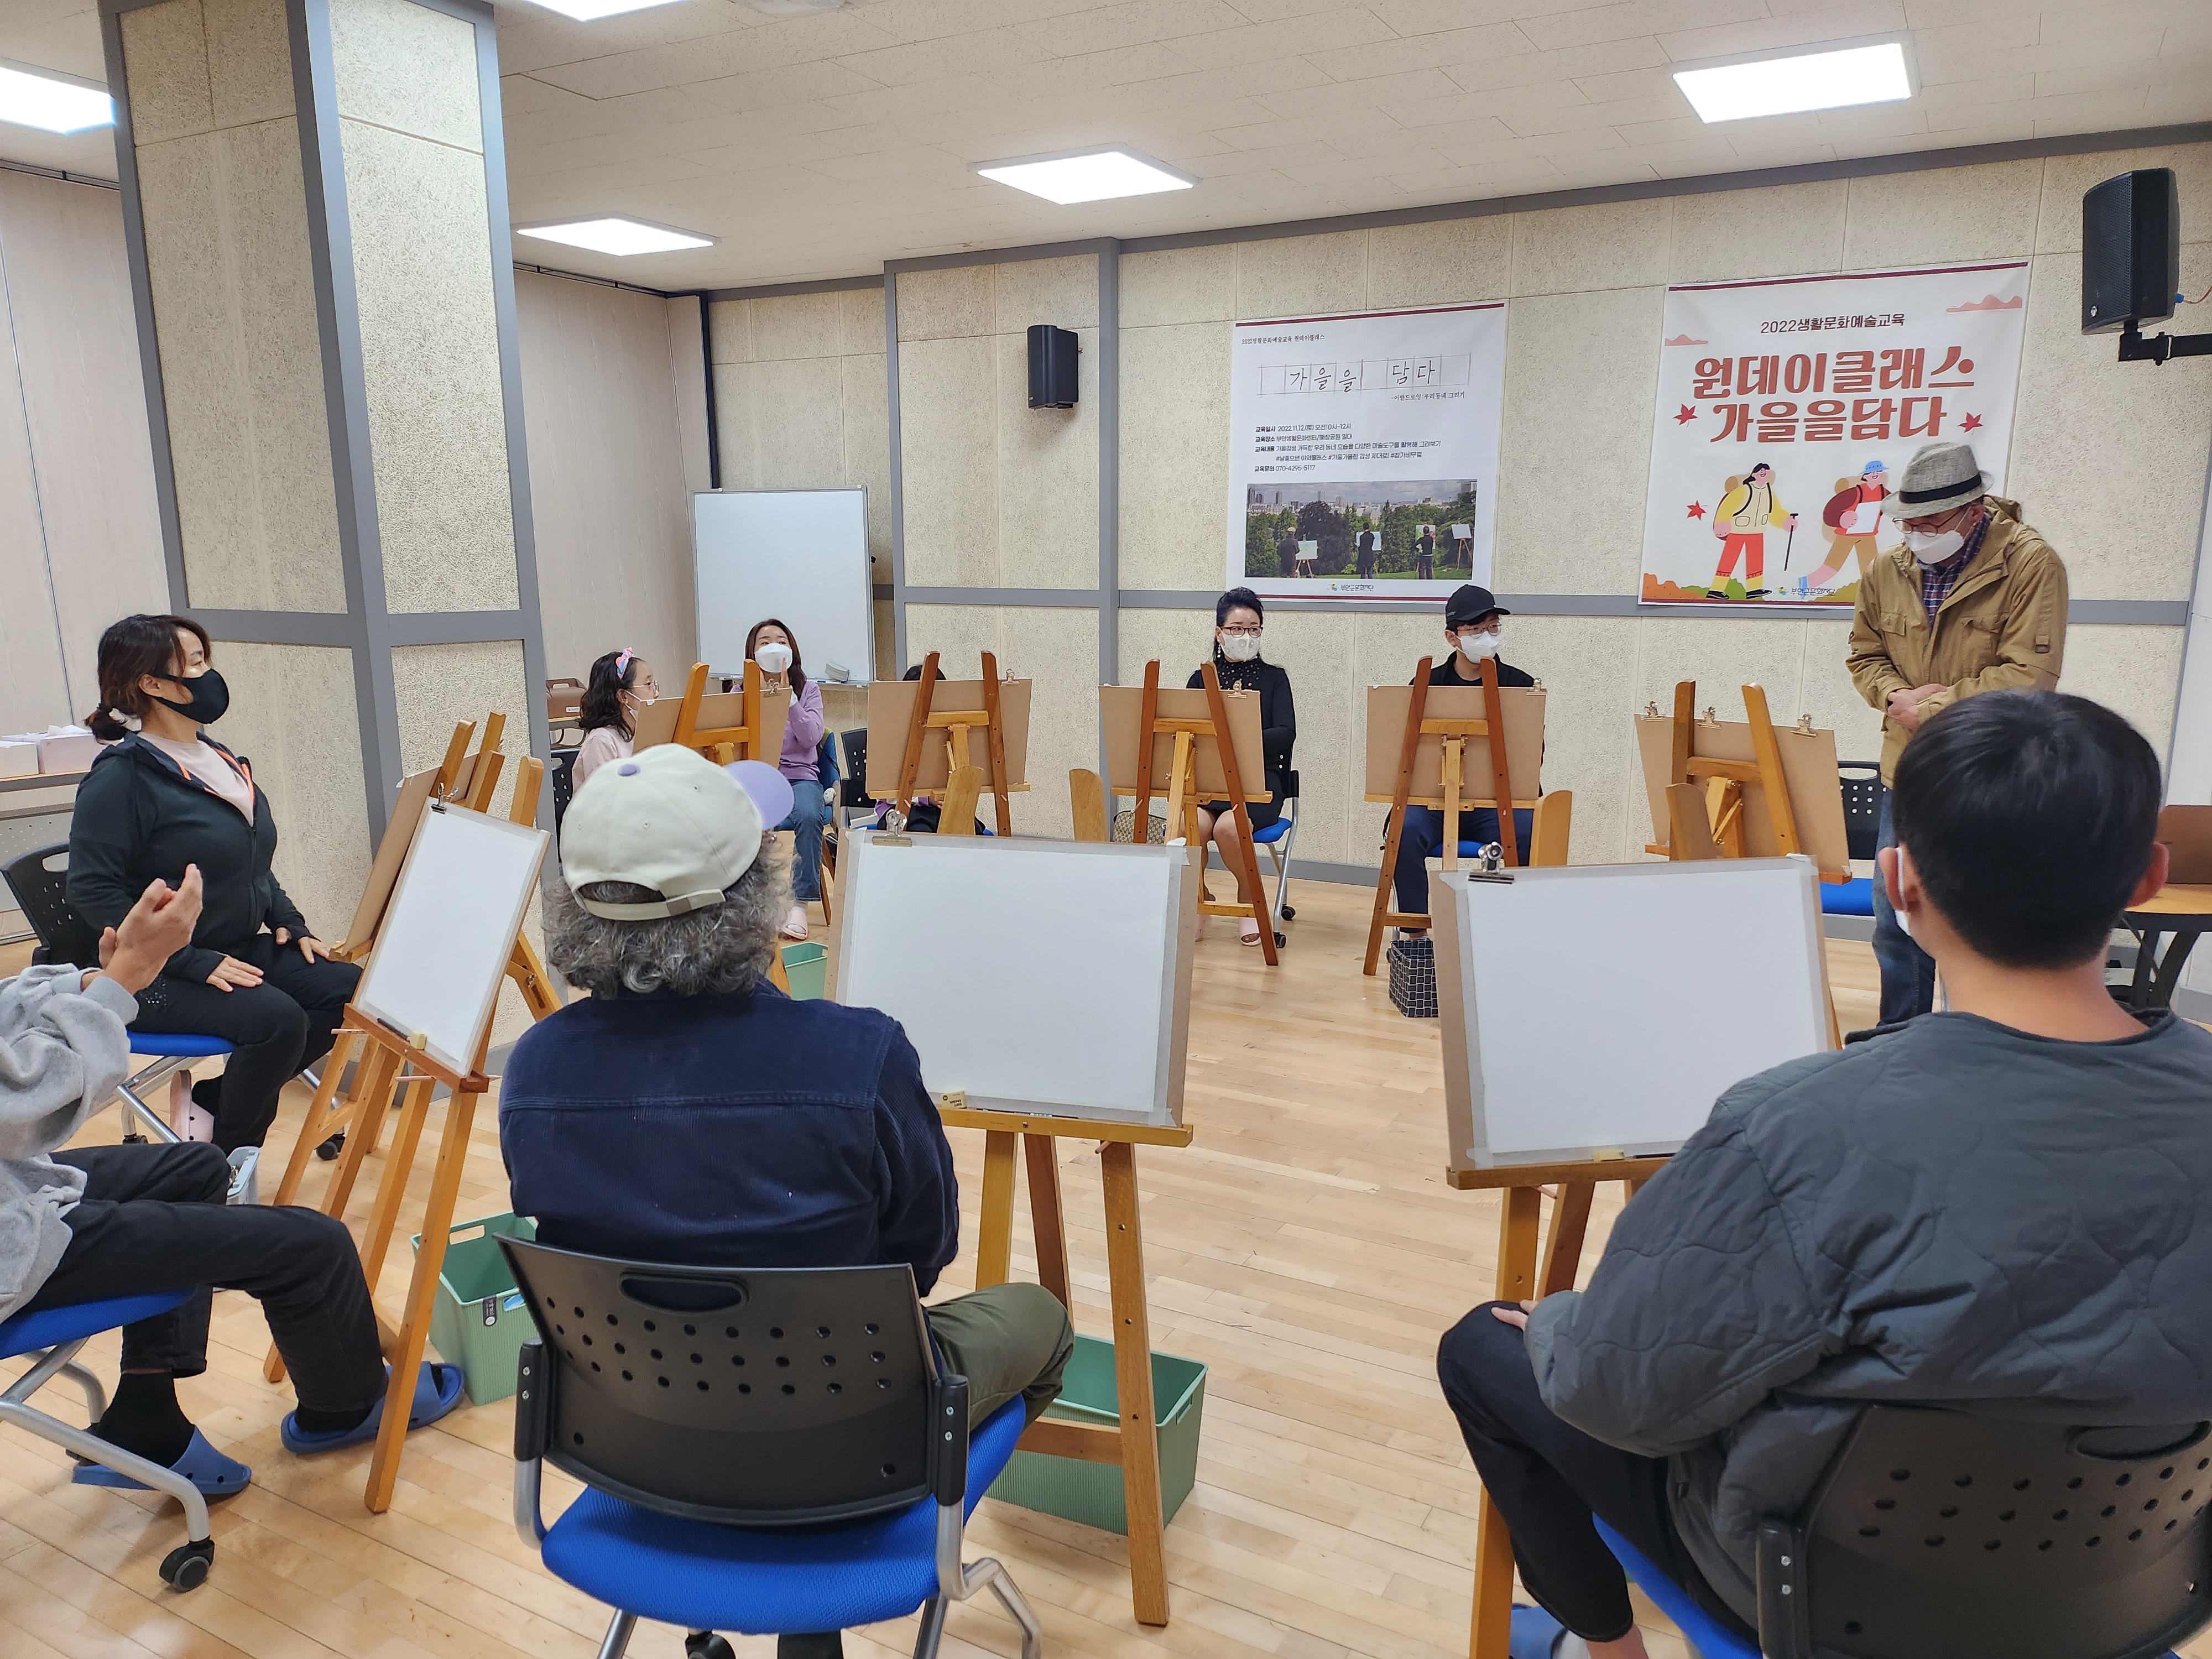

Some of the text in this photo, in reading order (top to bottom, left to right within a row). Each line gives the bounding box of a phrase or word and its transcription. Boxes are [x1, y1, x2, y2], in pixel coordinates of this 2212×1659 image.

[1241, 335, 1292, 345] 2022생활문화예술교육
[1760, 313, 1906, 334] 2022생활문화예술교육
[1290, 360, 1436, 393] 가을을 담다
[1692, 346, 1975, 399] 원데이클래스
[1710, 395, 1947, 444] 가을을담다
